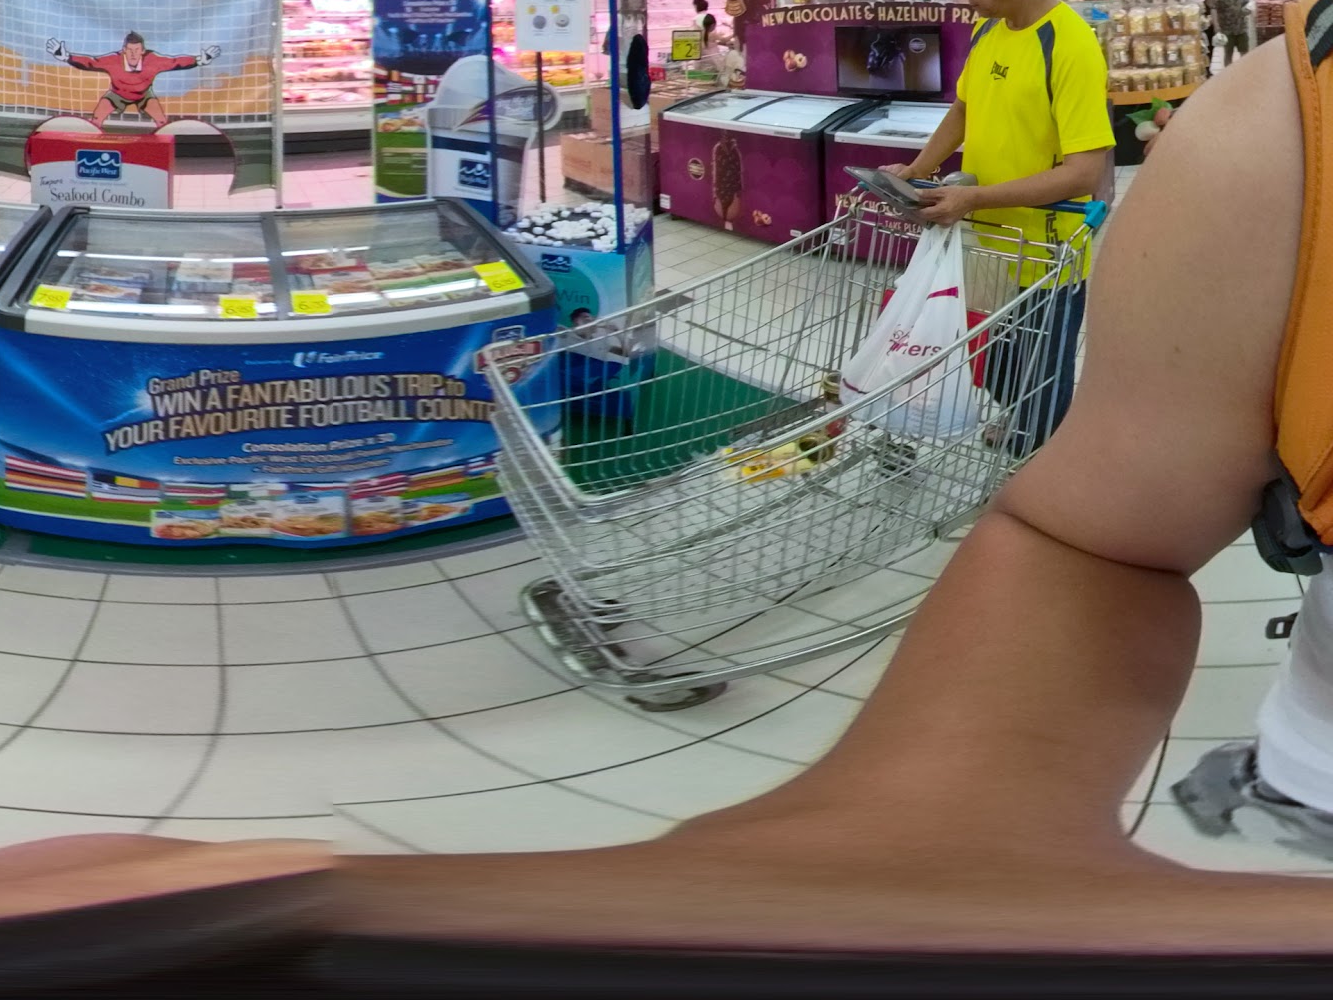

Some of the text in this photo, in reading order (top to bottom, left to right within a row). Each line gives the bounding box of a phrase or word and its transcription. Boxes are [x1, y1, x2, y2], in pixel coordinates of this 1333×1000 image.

[762, 11, 784, 28] NEW
[786, 5, 862, 24] CHOCOLATE
[864, 4, 874, 20] &
[878, 5, 946, 22] HAZELNUT
[78, 167, 117, 176] Pacific West
[50, 188, 145, 207] Seafood Combo
[318, 351, 384, 363] FairPrice
[148, 368, 241, 395] Grand Prize
[154, 374, 466, 417] WIN A FANTABULOUS TRIP to
[105, 420, 165, 451] YOUR
[168, 406, 295, 438] FAVOURITE
[299, 399, 413, 428] FOOTBALL
